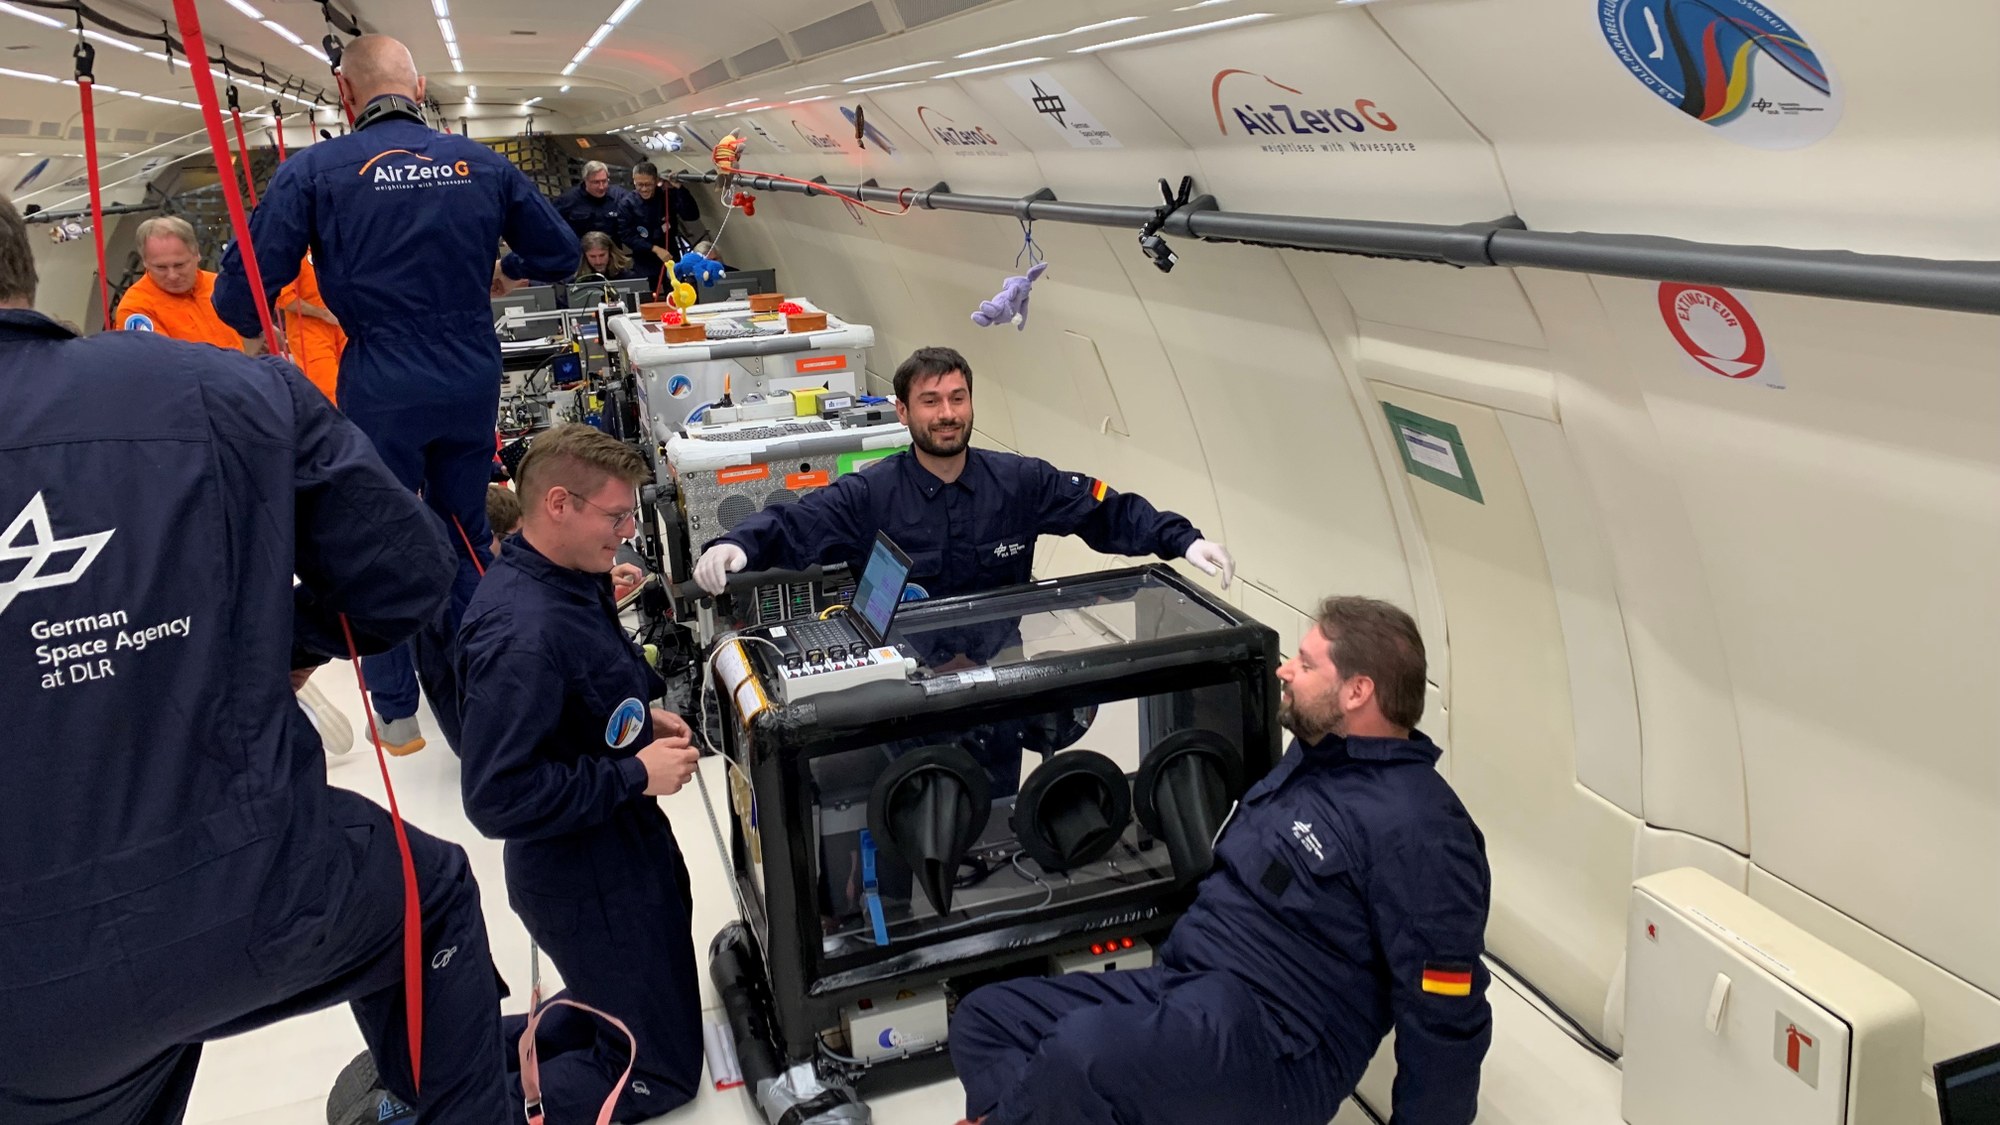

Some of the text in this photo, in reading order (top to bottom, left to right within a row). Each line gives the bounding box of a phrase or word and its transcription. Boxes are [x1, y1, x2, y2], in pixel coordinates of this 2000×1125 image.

[1603, 0, 1656, 85] DLR-PARABELFLU
[1232, 98, 1398, 135] AirZeroG
[1261, 141, 1416, 155] weightless with Novespace
[375, 183, 414, 191] weightless
[1678, 292, 1738, 327] EXTINCTEUR
[31, 609, 128, 640] German
[35, 615, 191, 667] Space Agency
[41, 658, 115, 689] at DLR
